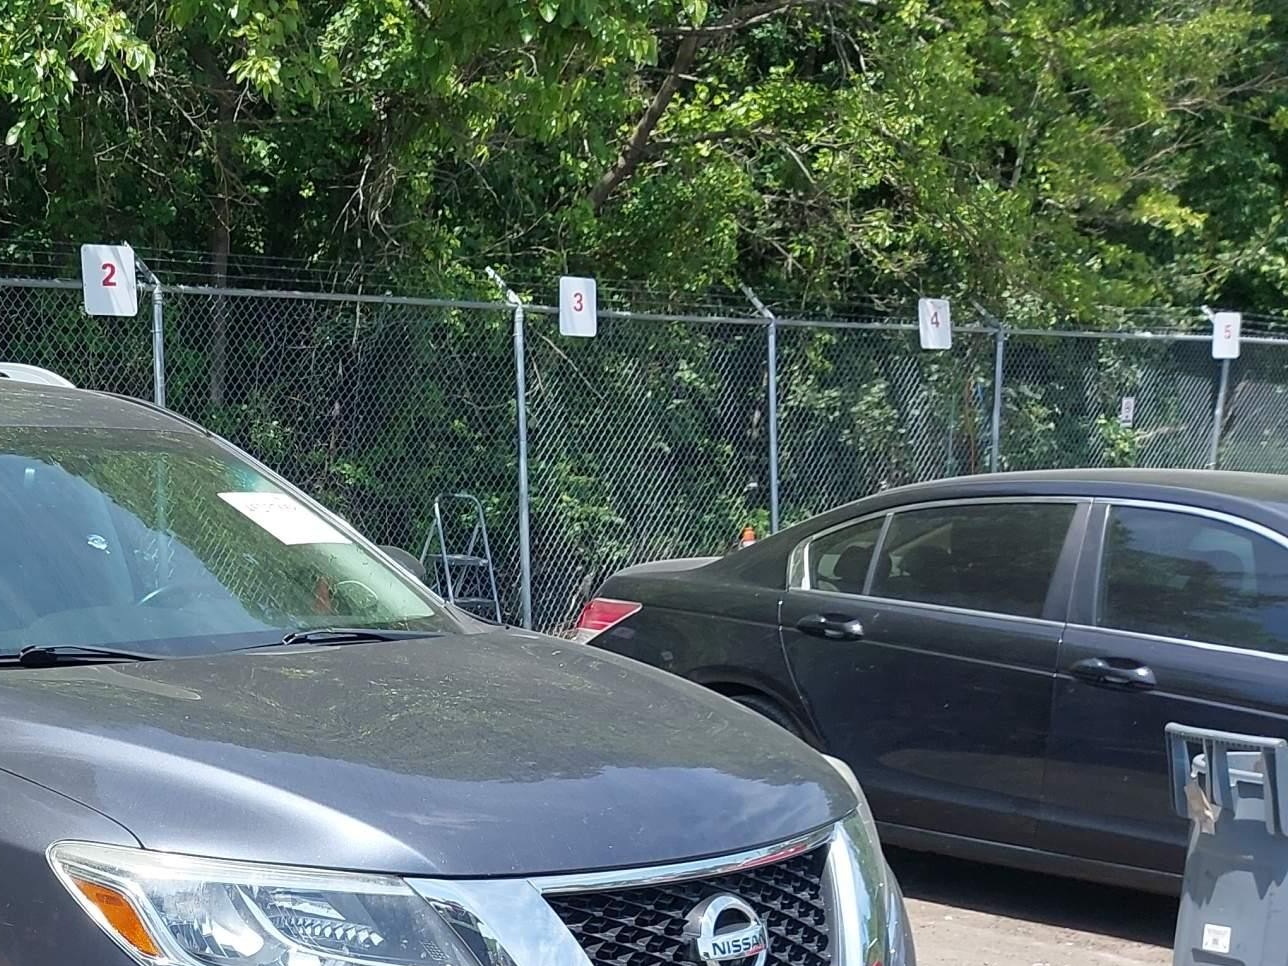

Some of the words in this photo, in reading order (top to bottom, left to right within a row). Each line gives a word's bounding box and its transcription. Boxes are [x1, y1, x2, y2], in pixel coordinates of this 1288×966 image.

[101, 263, 117, 287] 2
[573, 292, 584, 312] 3
[930, 311, 940, 329] 4
[1223, 323, 1232, 340] 5
